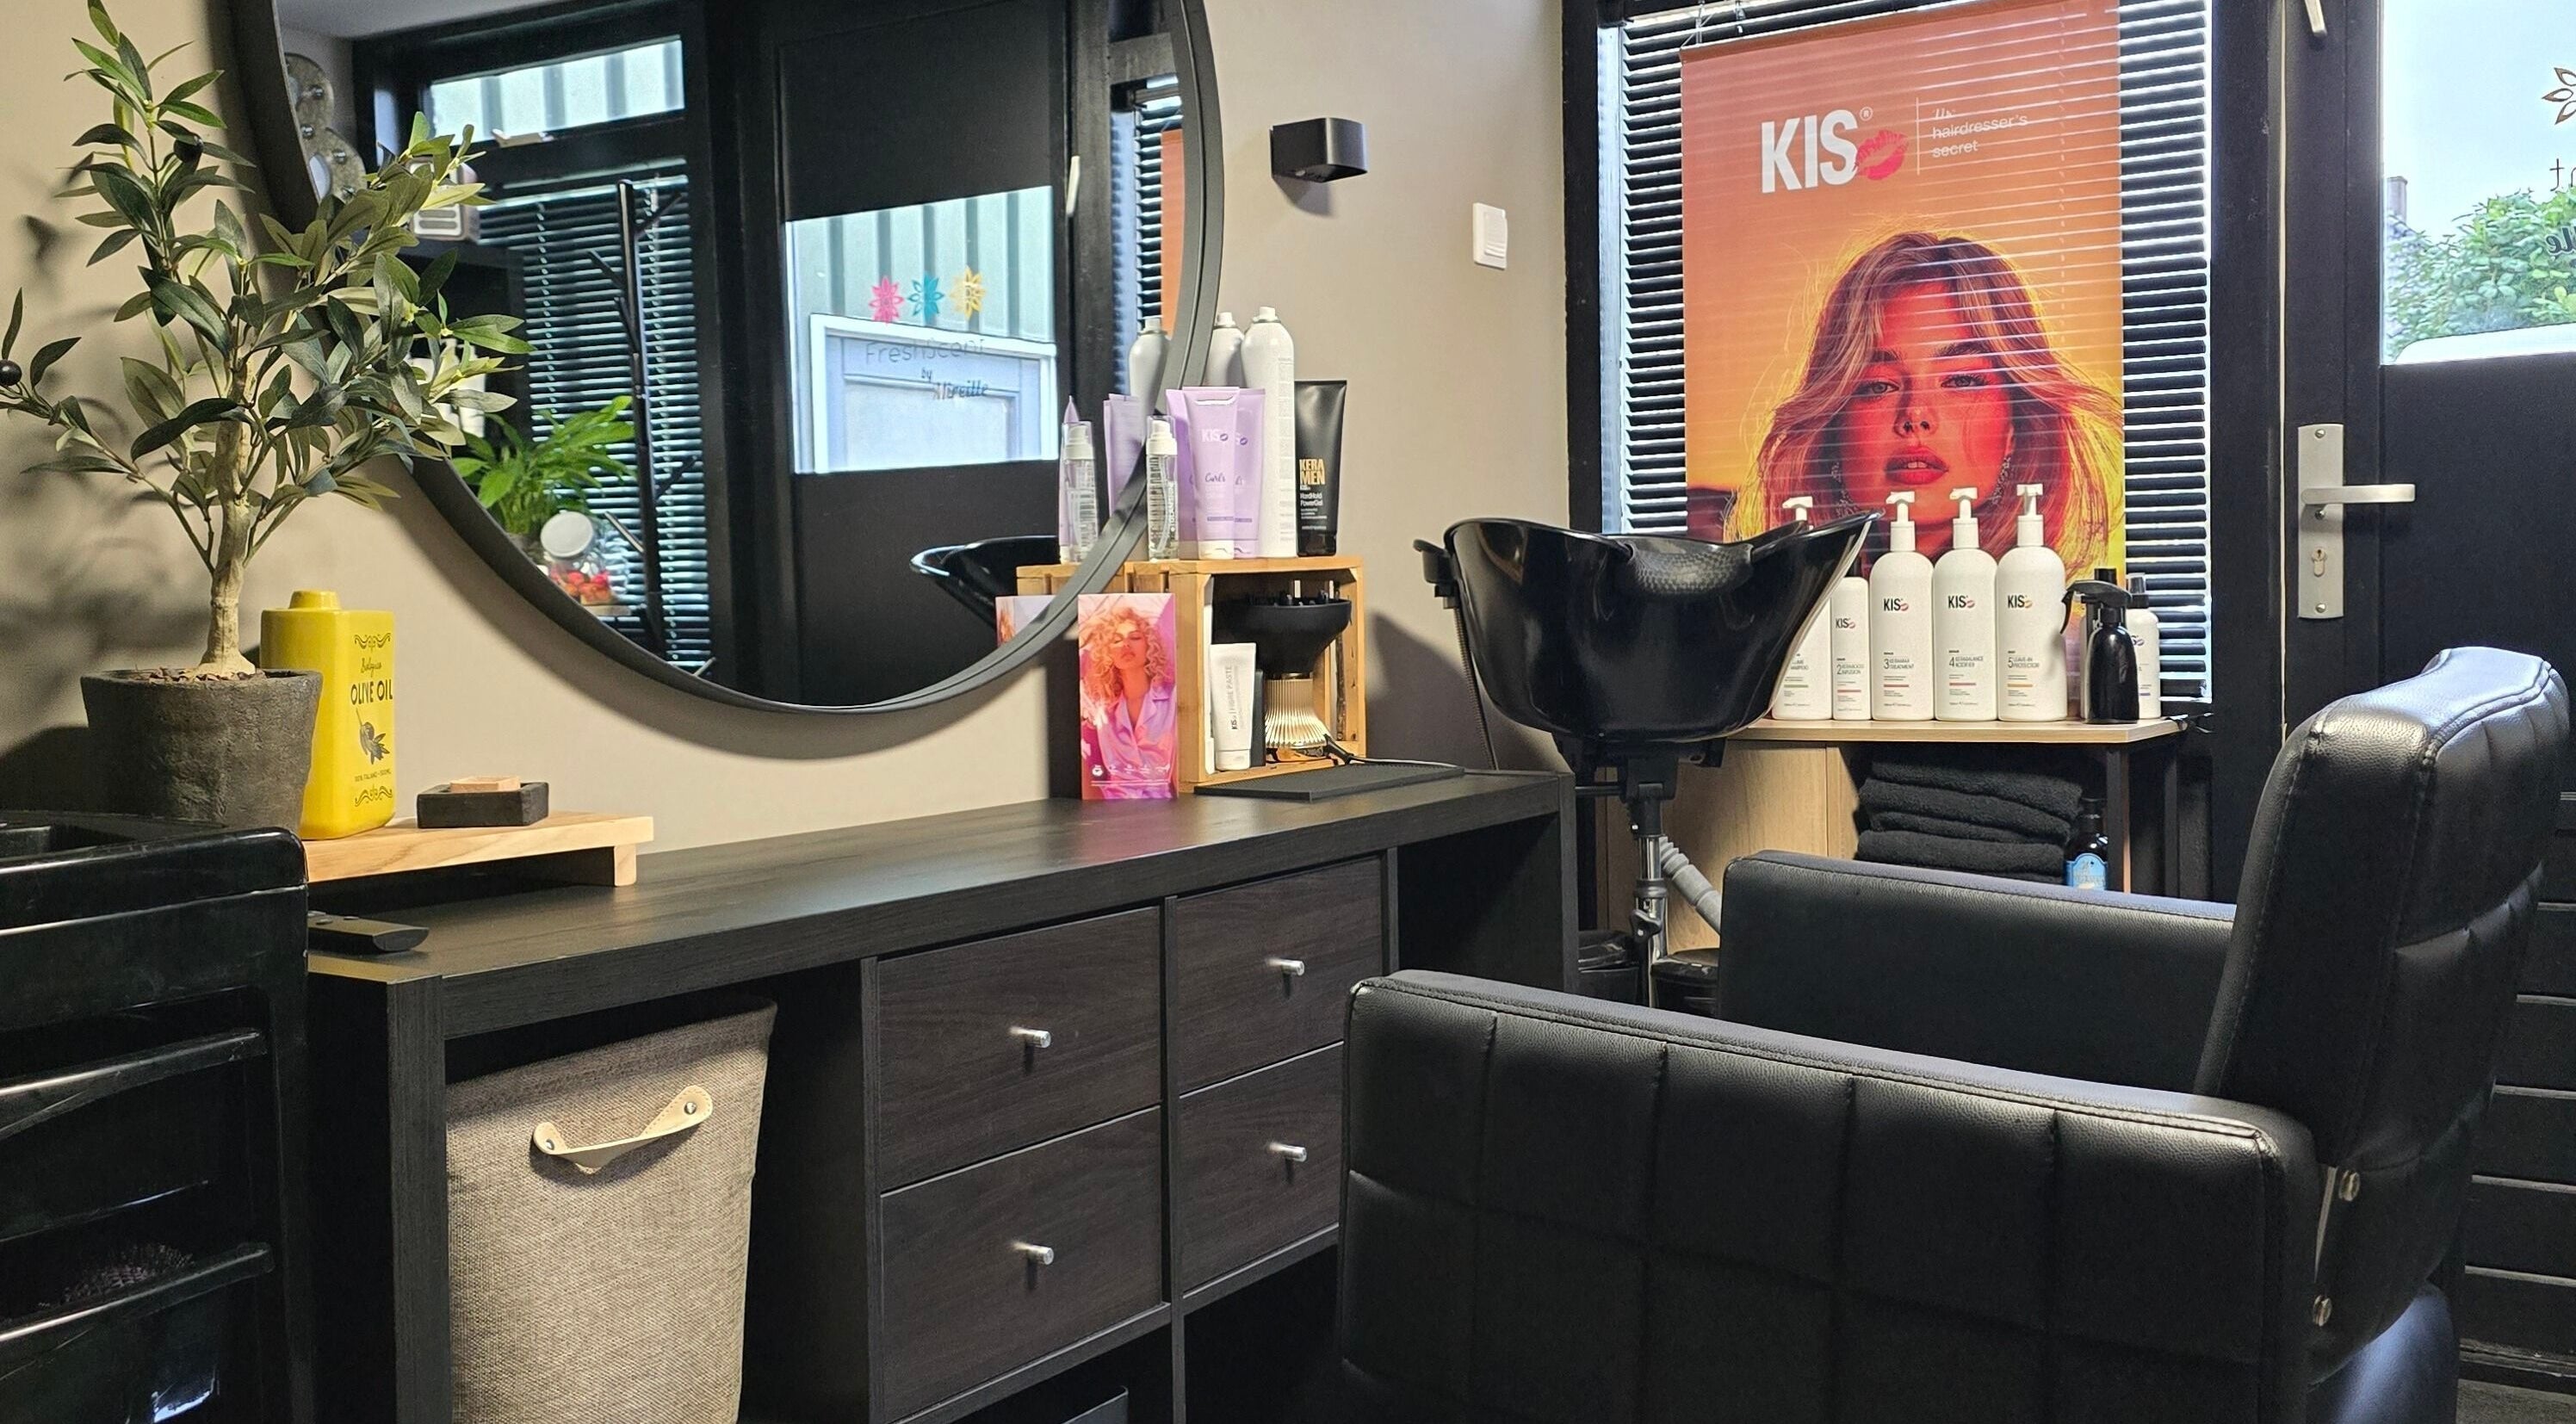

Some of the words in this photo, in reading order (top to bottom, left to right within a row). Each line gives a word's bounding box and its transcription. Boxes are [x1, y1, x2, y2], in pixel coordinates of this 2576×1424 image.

[1932, 115, 2028, 139] hairdresser's
[1932, 139, 1978, 158] secret
[1299, 459, 1323, 471] KERA
[1300, 470, 1325, 485] MEN
[1884, 598, 1901, 611] KIS
[1948, 596, 1966, 609] KIS
[2008, 595, 2025, 609] KIS
[1836, 617, 1849, 629] KIS
[1884, 658, 1890, 670] 3
[1948, 657, 1955, 668] 4
[2008, 657, 2014, 668] 5
[1836, 664, 1842, 675] 2
[350, 681, 374, 705] OLIVE
[376, 678, 393, 702] OIL
